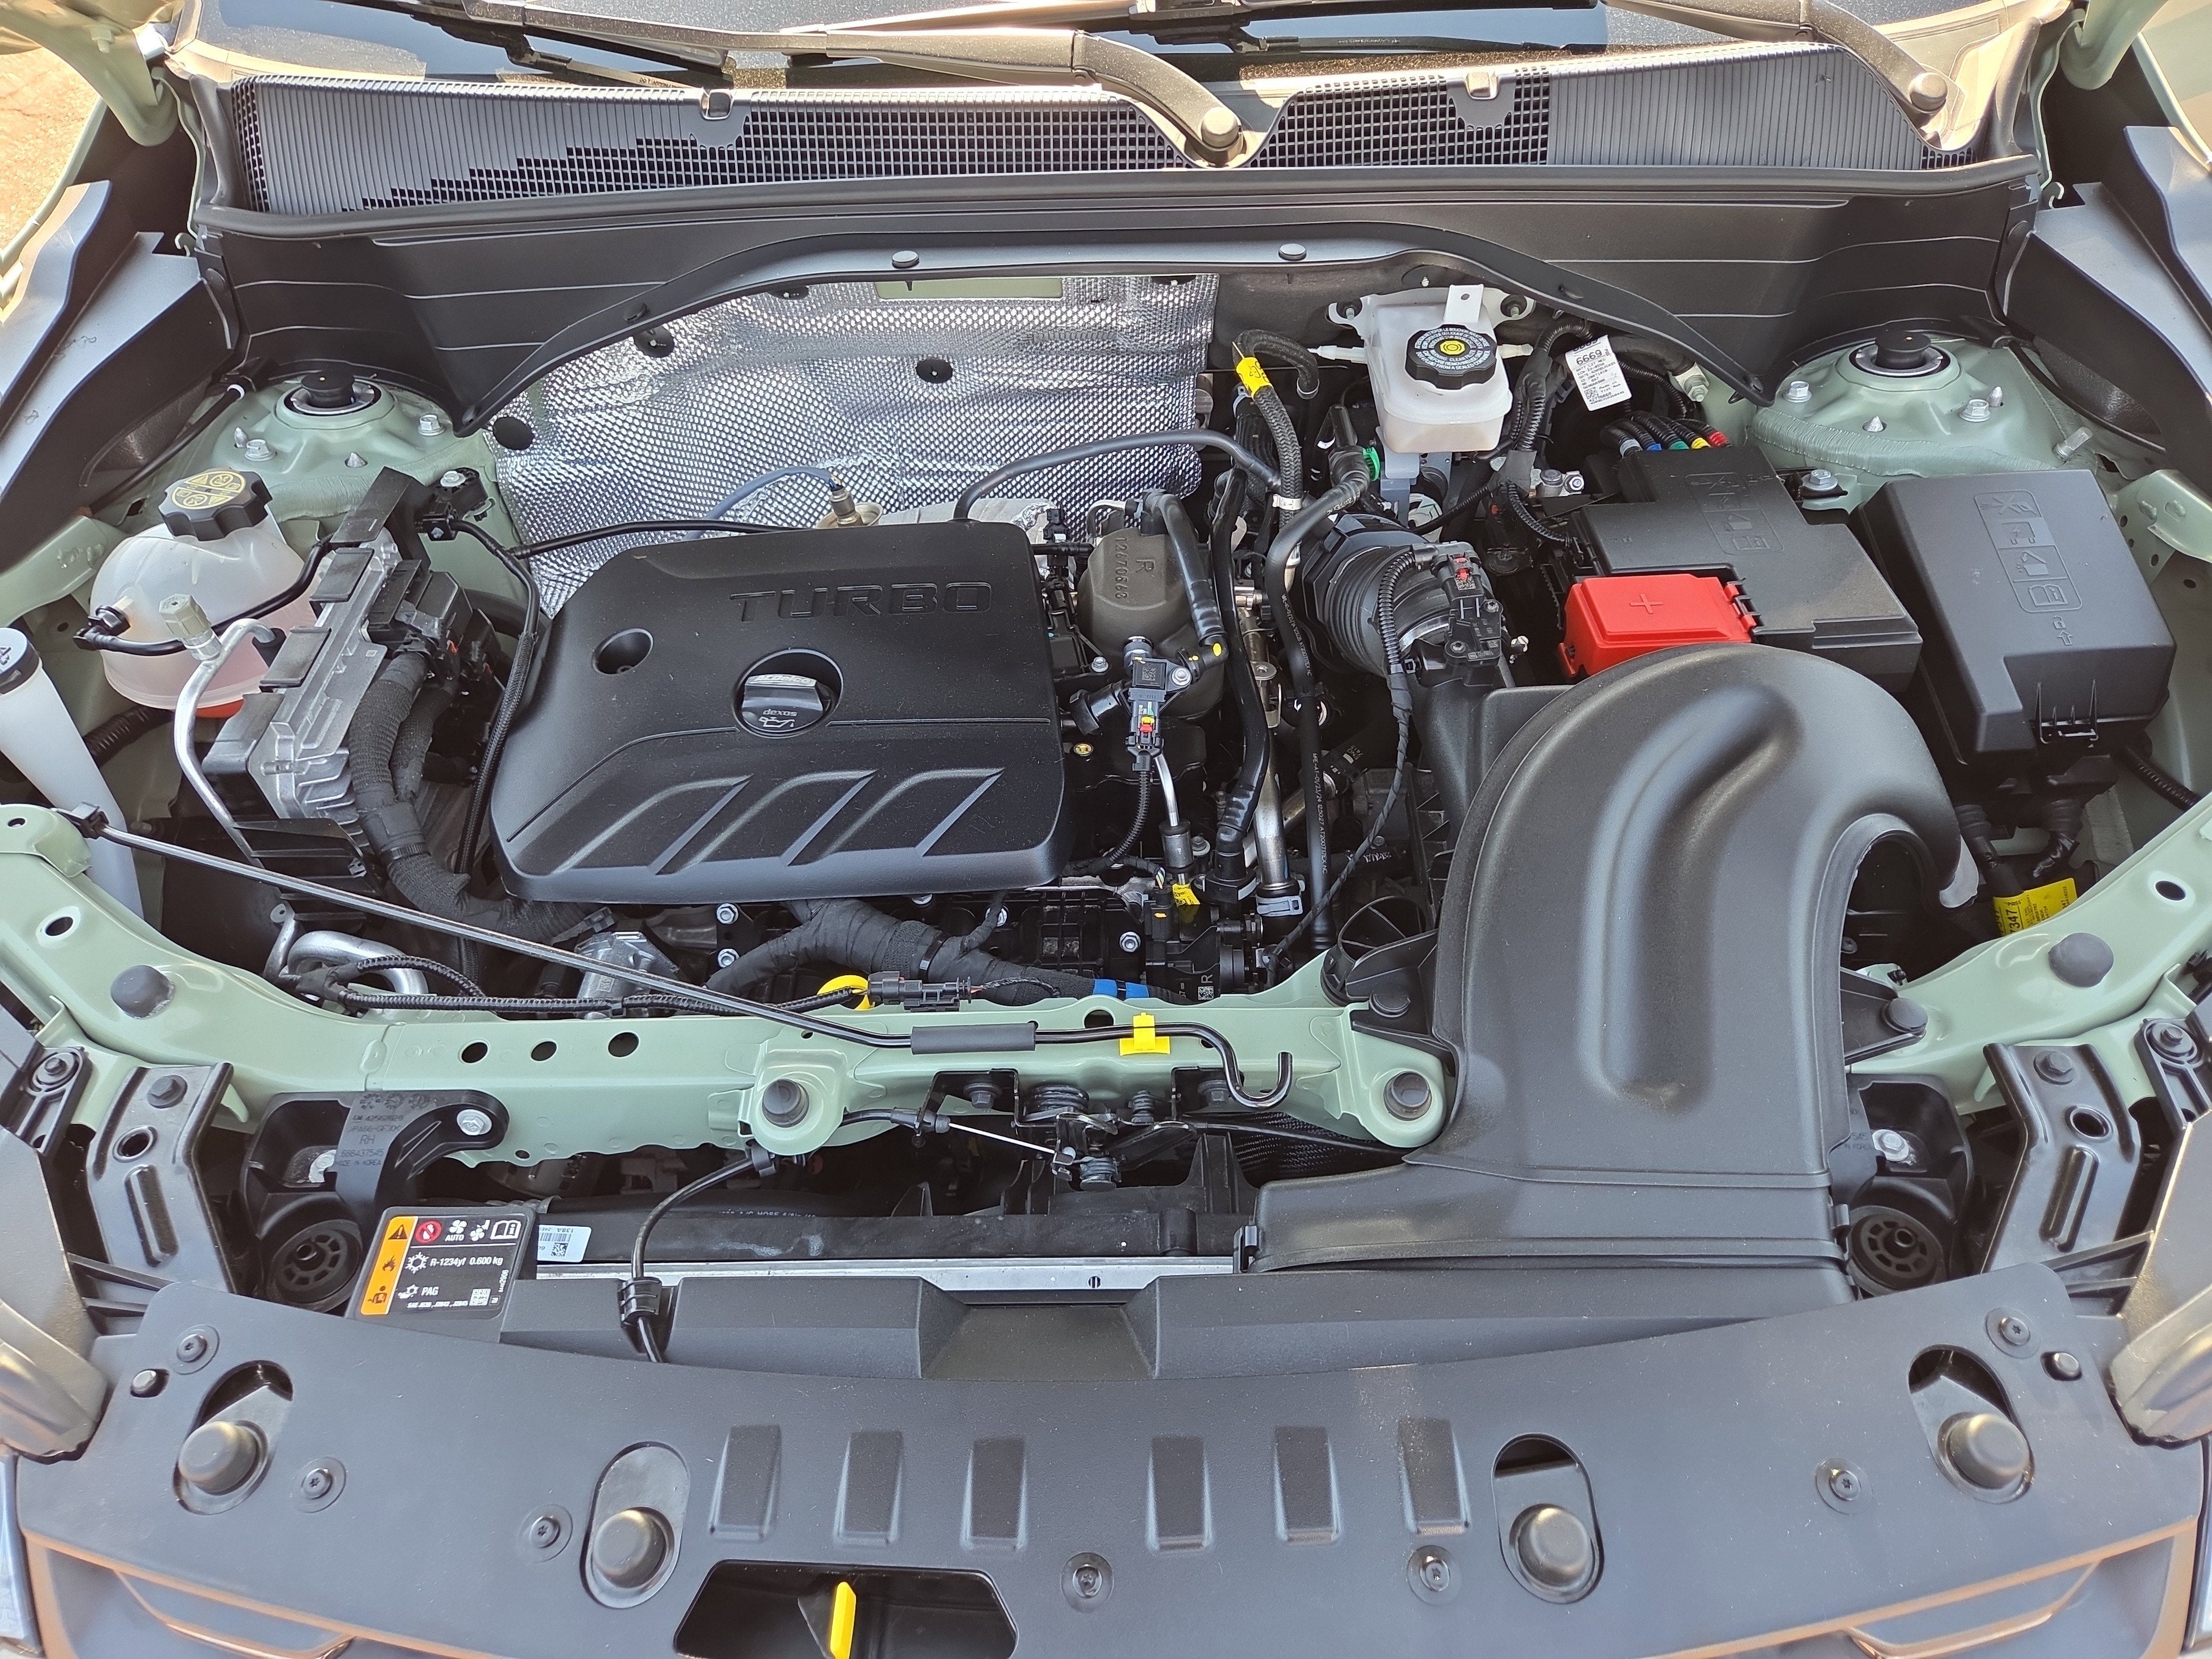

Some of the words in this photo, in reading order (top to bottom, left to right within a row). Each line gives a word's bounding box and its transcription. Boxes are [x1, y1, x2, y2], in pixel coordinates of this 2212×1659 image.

[1576, 349, 1602, 365] 6669
[1136, 560, 1155, 573] R
[730, 582, 992, 622] TURBO
[763, 708, 798, 717] dexos
[1201, 974, 1213, 983] R
[359, 1135, 376, 1144] RH
[430, 1258, 466, 1267] R-1234yf
[470, 1256, 491, 1265] 0.600
[492, 1257, 504, 1266] kg
[421, 1287, 440, 1296] PAG
